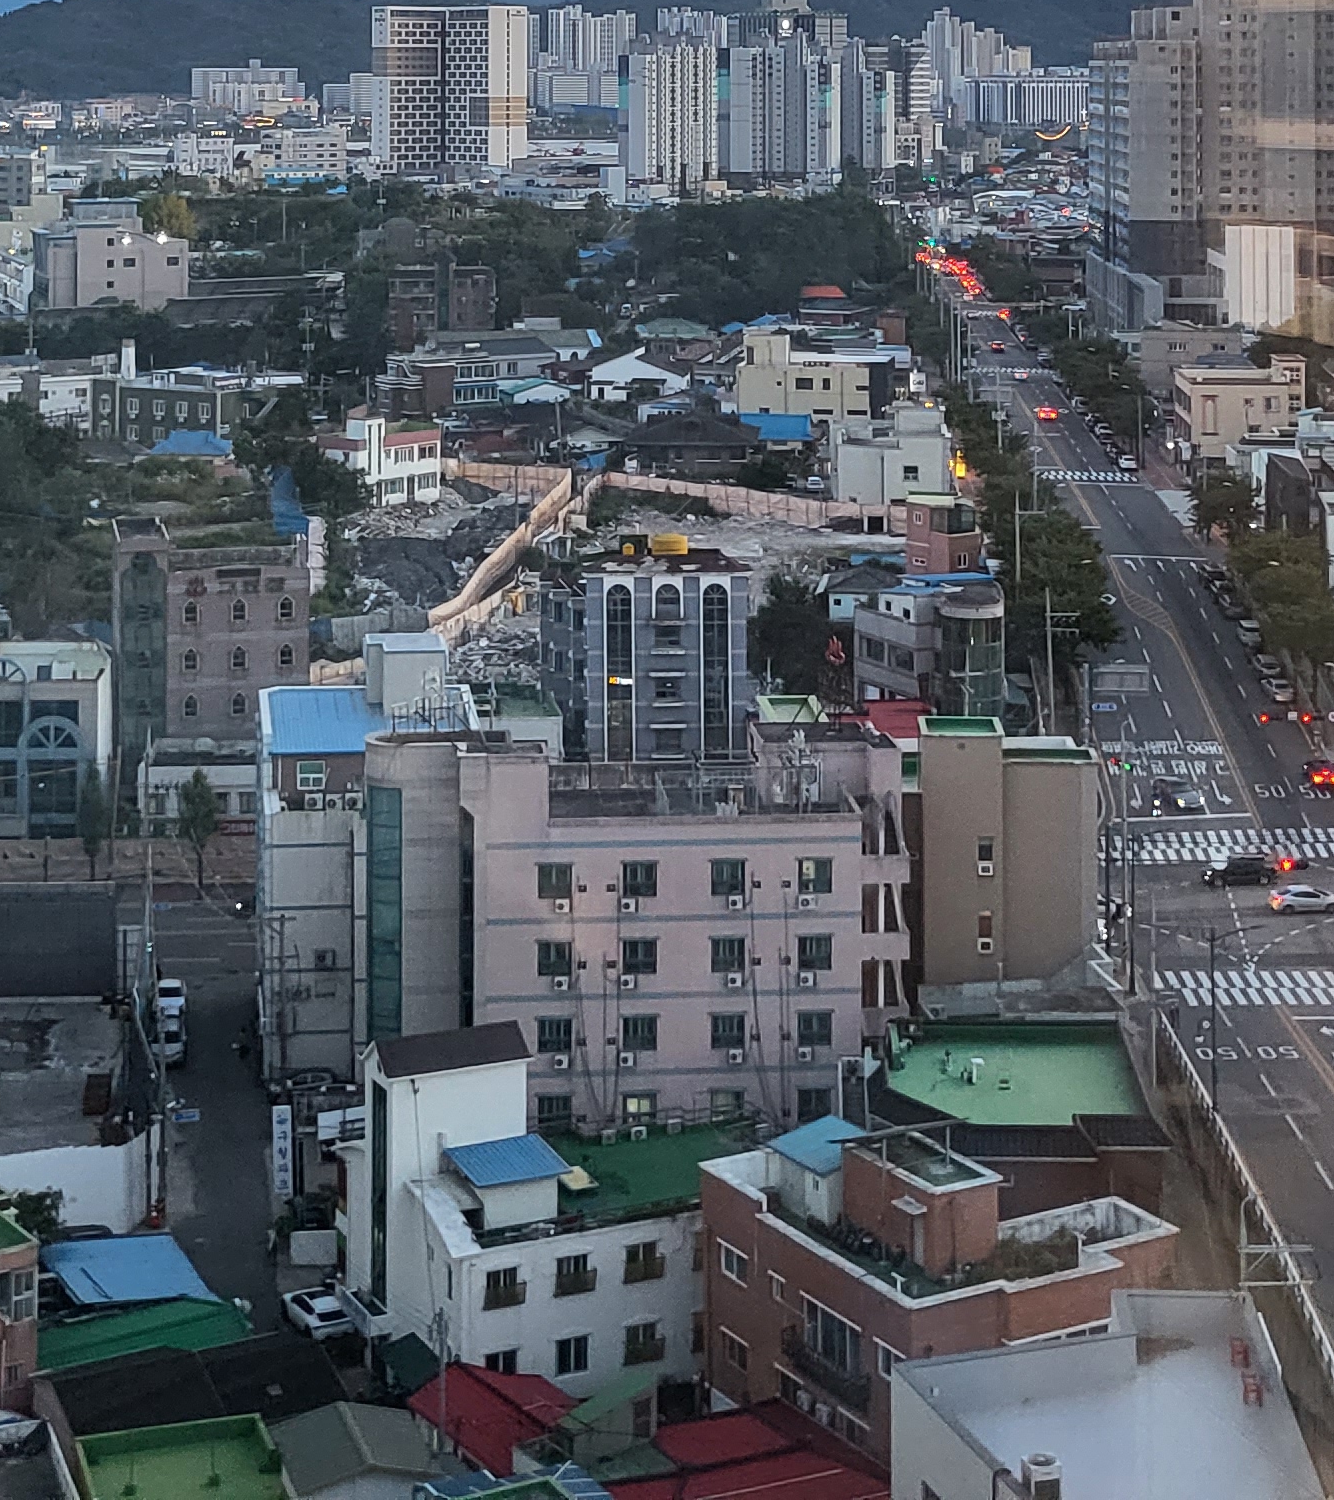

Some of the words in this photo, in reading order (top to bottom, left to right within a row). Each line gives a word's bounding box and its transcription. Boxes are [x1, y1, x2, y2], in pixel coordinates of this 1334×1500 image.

[1254, 783, 1285, 798] 50
[1299, 784, 1331, 799] 50
[1195, 1046, 1239, 1060] 50
[1257, 1045, 1299, 1060] 50
